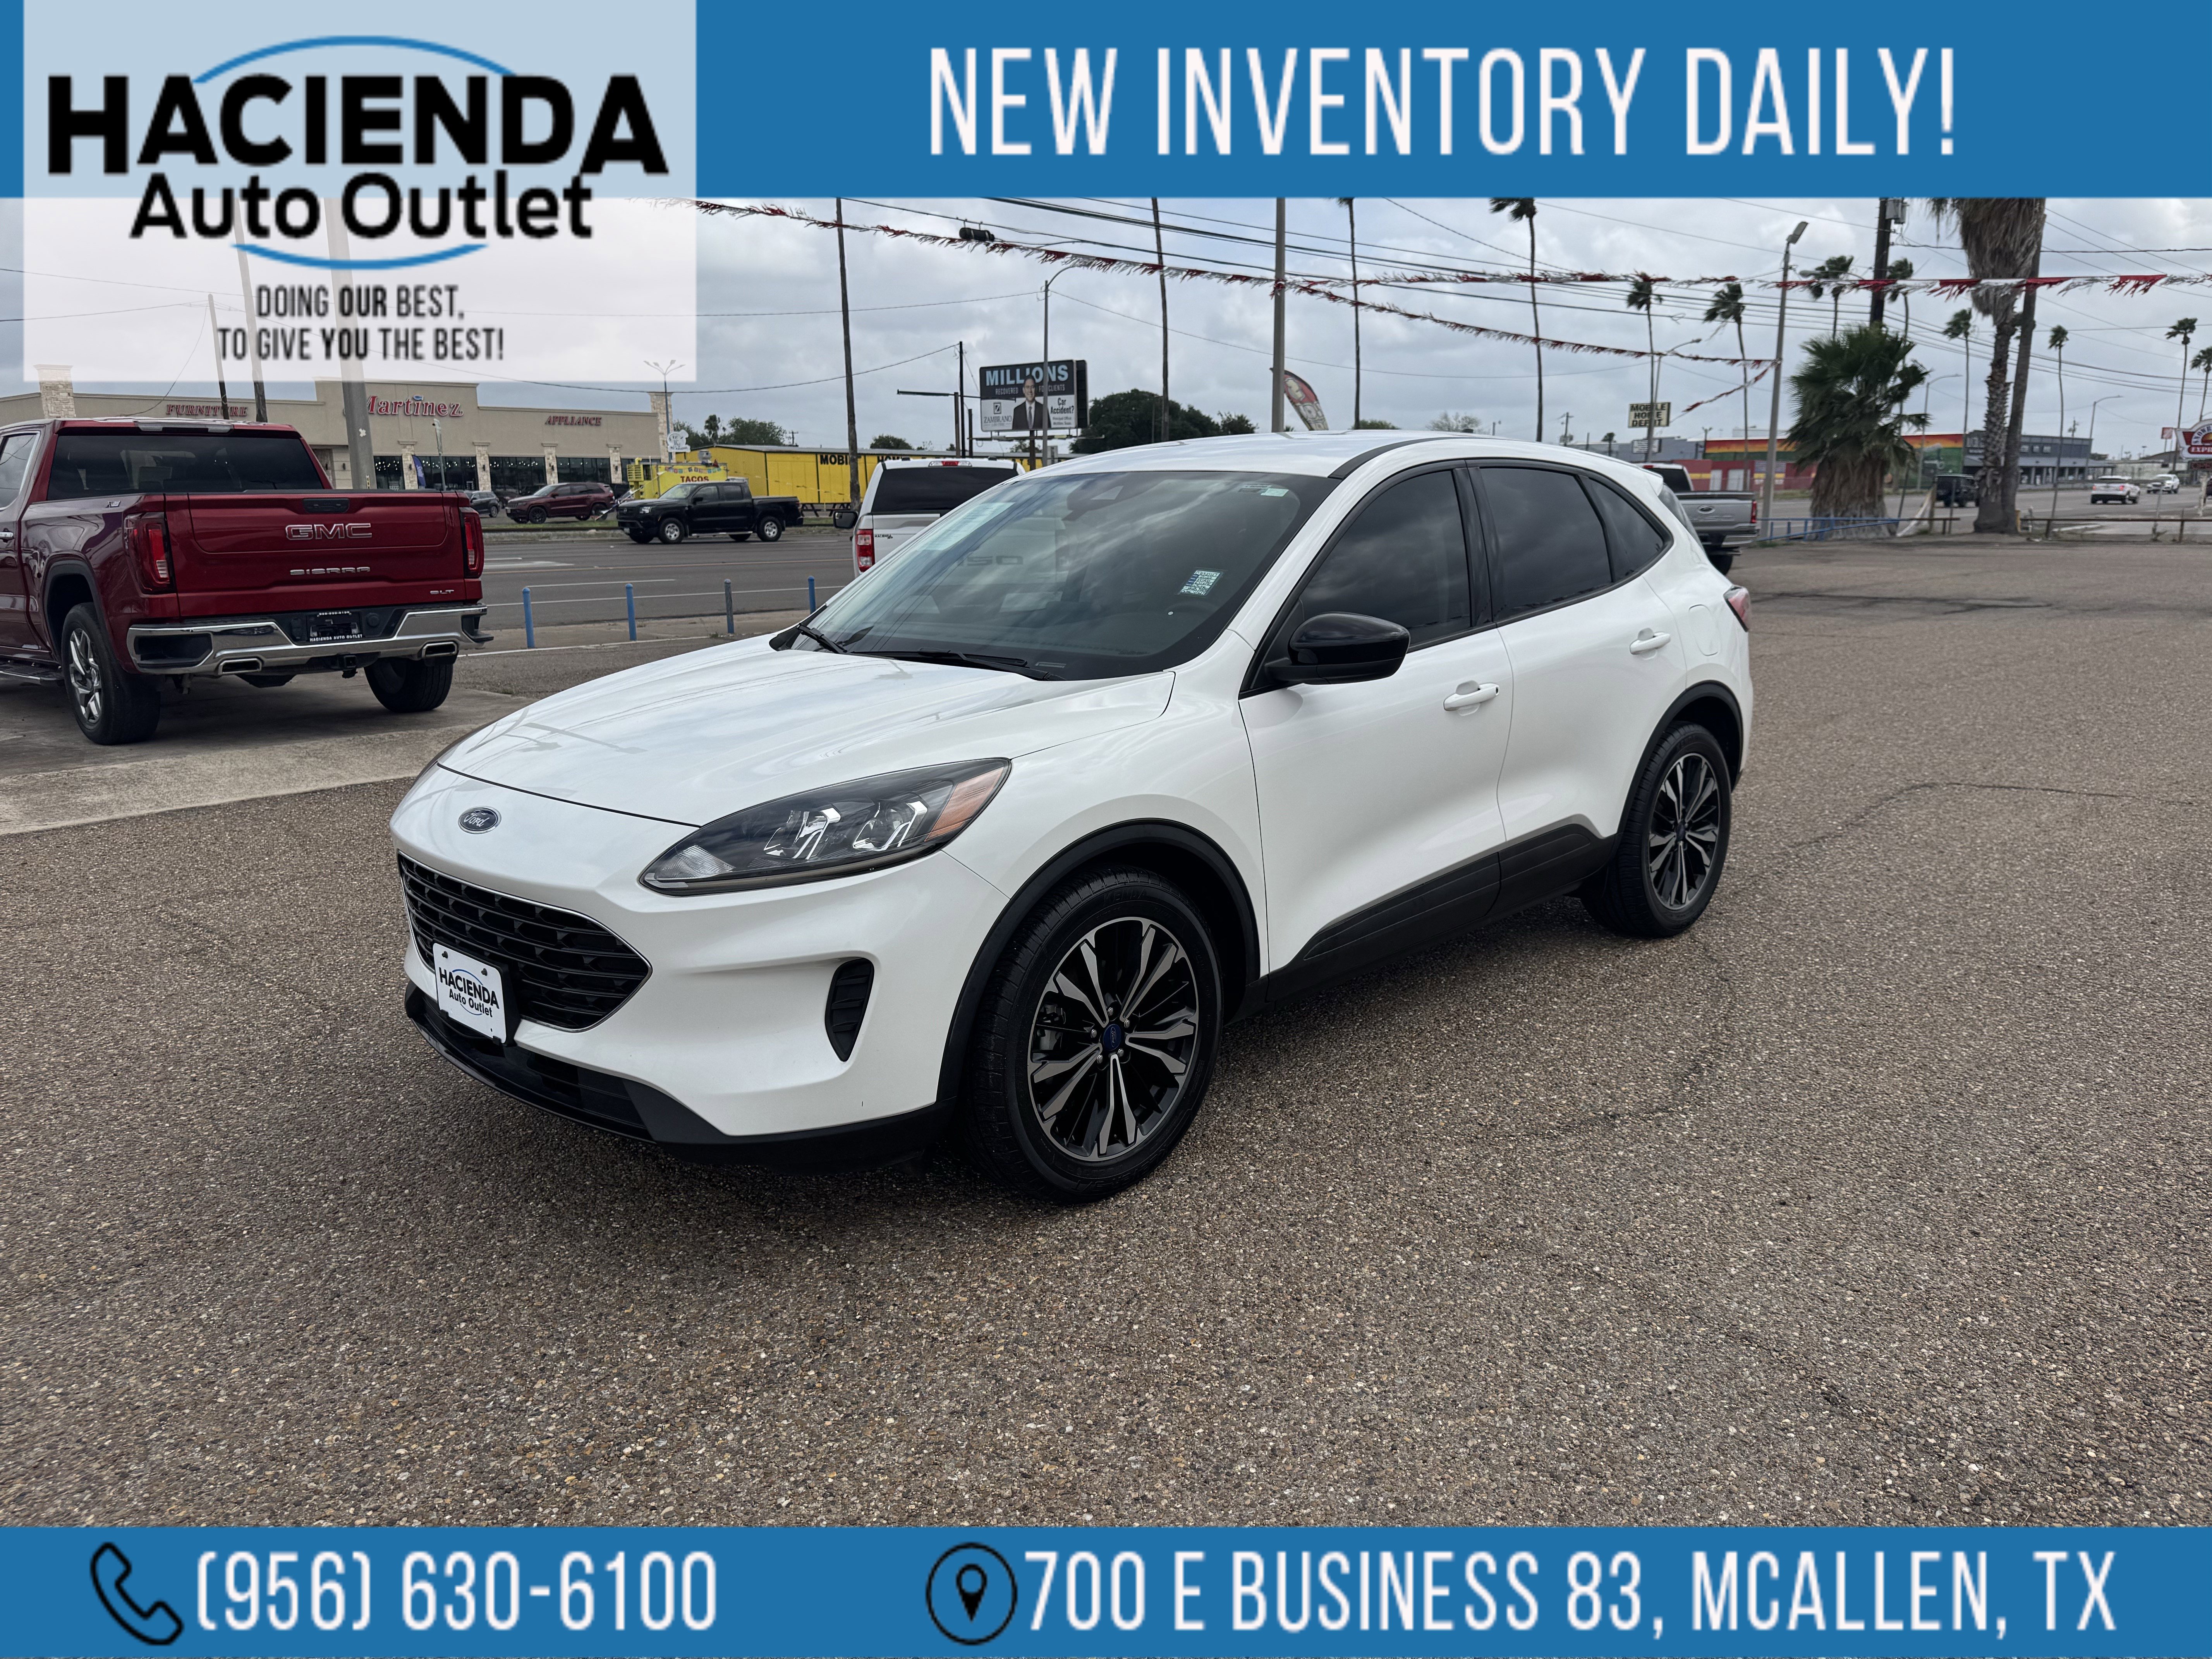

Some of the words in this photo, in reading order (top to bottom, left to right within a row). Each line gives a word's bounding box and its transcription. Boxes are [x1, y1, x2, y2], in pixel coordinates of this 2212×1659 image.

[1058, 397, 1066, 405] Car
[166, 404, 248, 417] FURNITRE
[1051, 405, 1074, 415] Accident?
[545, 416, 602, 426] APPLIANCE
[819, 454, 849, 465] MOBI
[285, 523, 372, 541] GMC
[290, 567, 370, 575] SIERRA
[464, 809, 490, 827] Ford
[439, 967, 500, 1009] HACIENDA
[449, 988, 466, 1005] Auto
[468, 998, 493, 1018] Outlet
